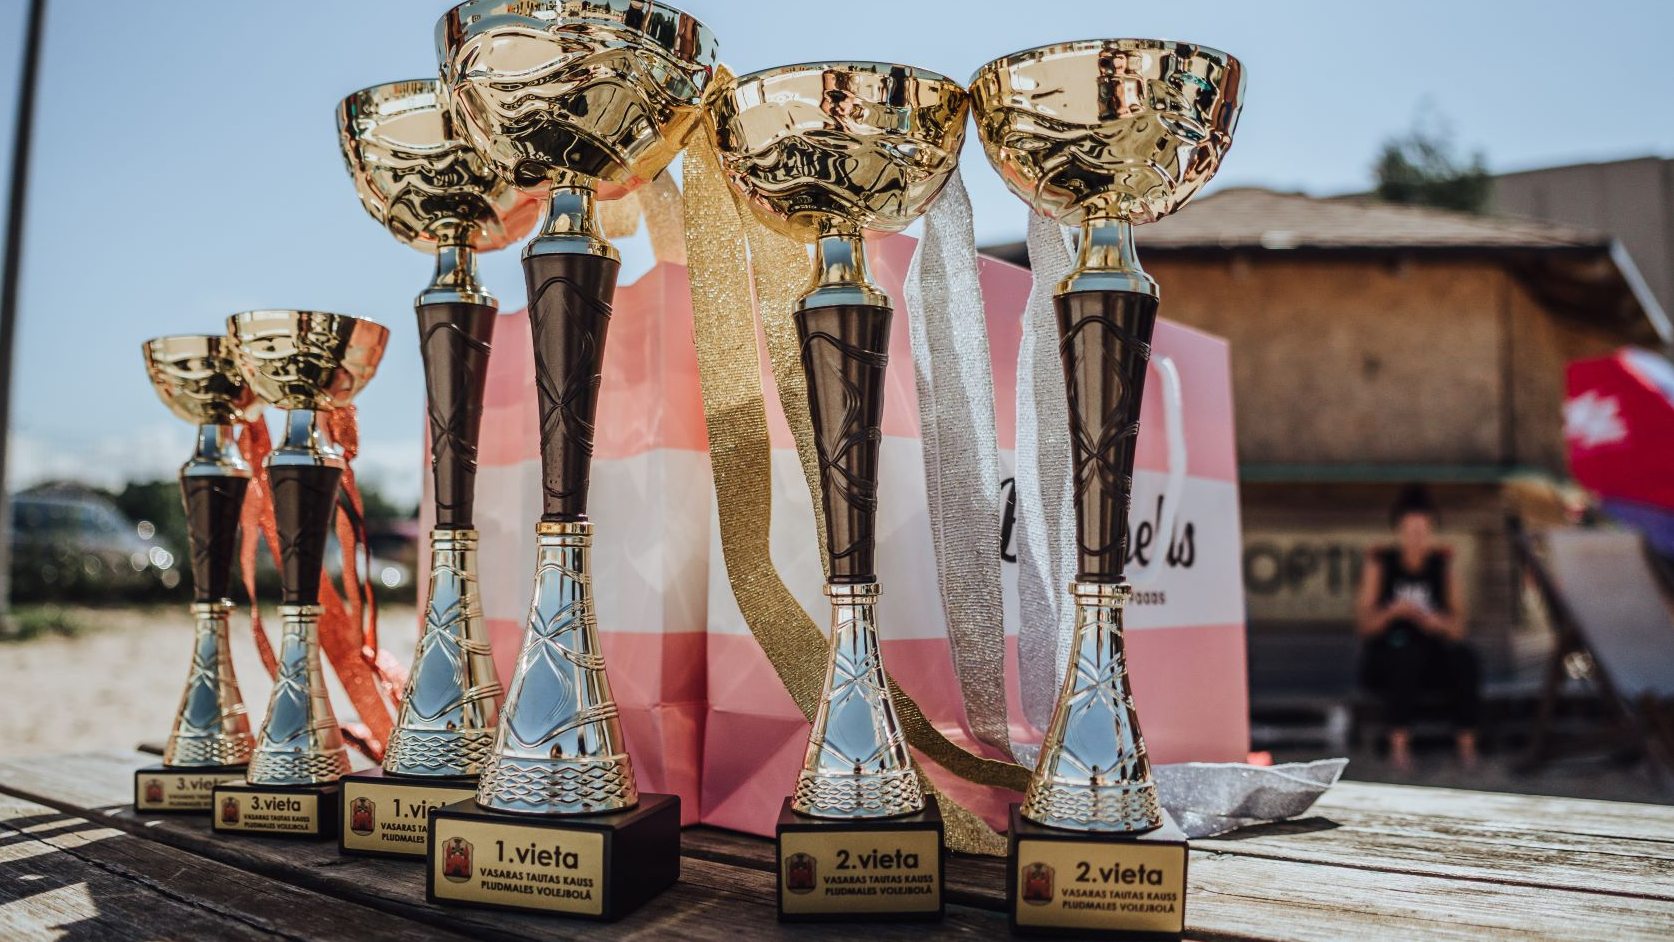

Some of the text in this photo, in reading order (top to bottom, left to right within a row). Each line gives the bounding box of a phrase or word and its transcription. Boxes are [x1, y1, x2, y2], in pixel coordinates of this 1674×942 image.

[1241, 543, 1363, 597] OPTI
[176, 777, 229, 791] 3.viet
[251, 796, 302, 812] 3.vieta
[380, 822, 417, 833] VASARAS
[381, 833, 425, 844] PLUDMALES
[495, 840, 579, 869] 1.vieta
[836, 849, 919, 870] 2.vieta
[480, 867, 594, 888] VASARAS TAUTAS KAUSS
[823, 874, 934, 884] VASARAS TAUTAS KAUSS
[1075, 861, 1163, 886] 2.vieta
[481, 880, 592, 900] PLUDMALES VOLEJBOLĀ
[825, 887, 877, 896] PLUDMALES
[1061, 888, 1178, 902] VASARAS TAUTAS KAUSS
[1062, 900, 1117, 911] PLUDMALES
